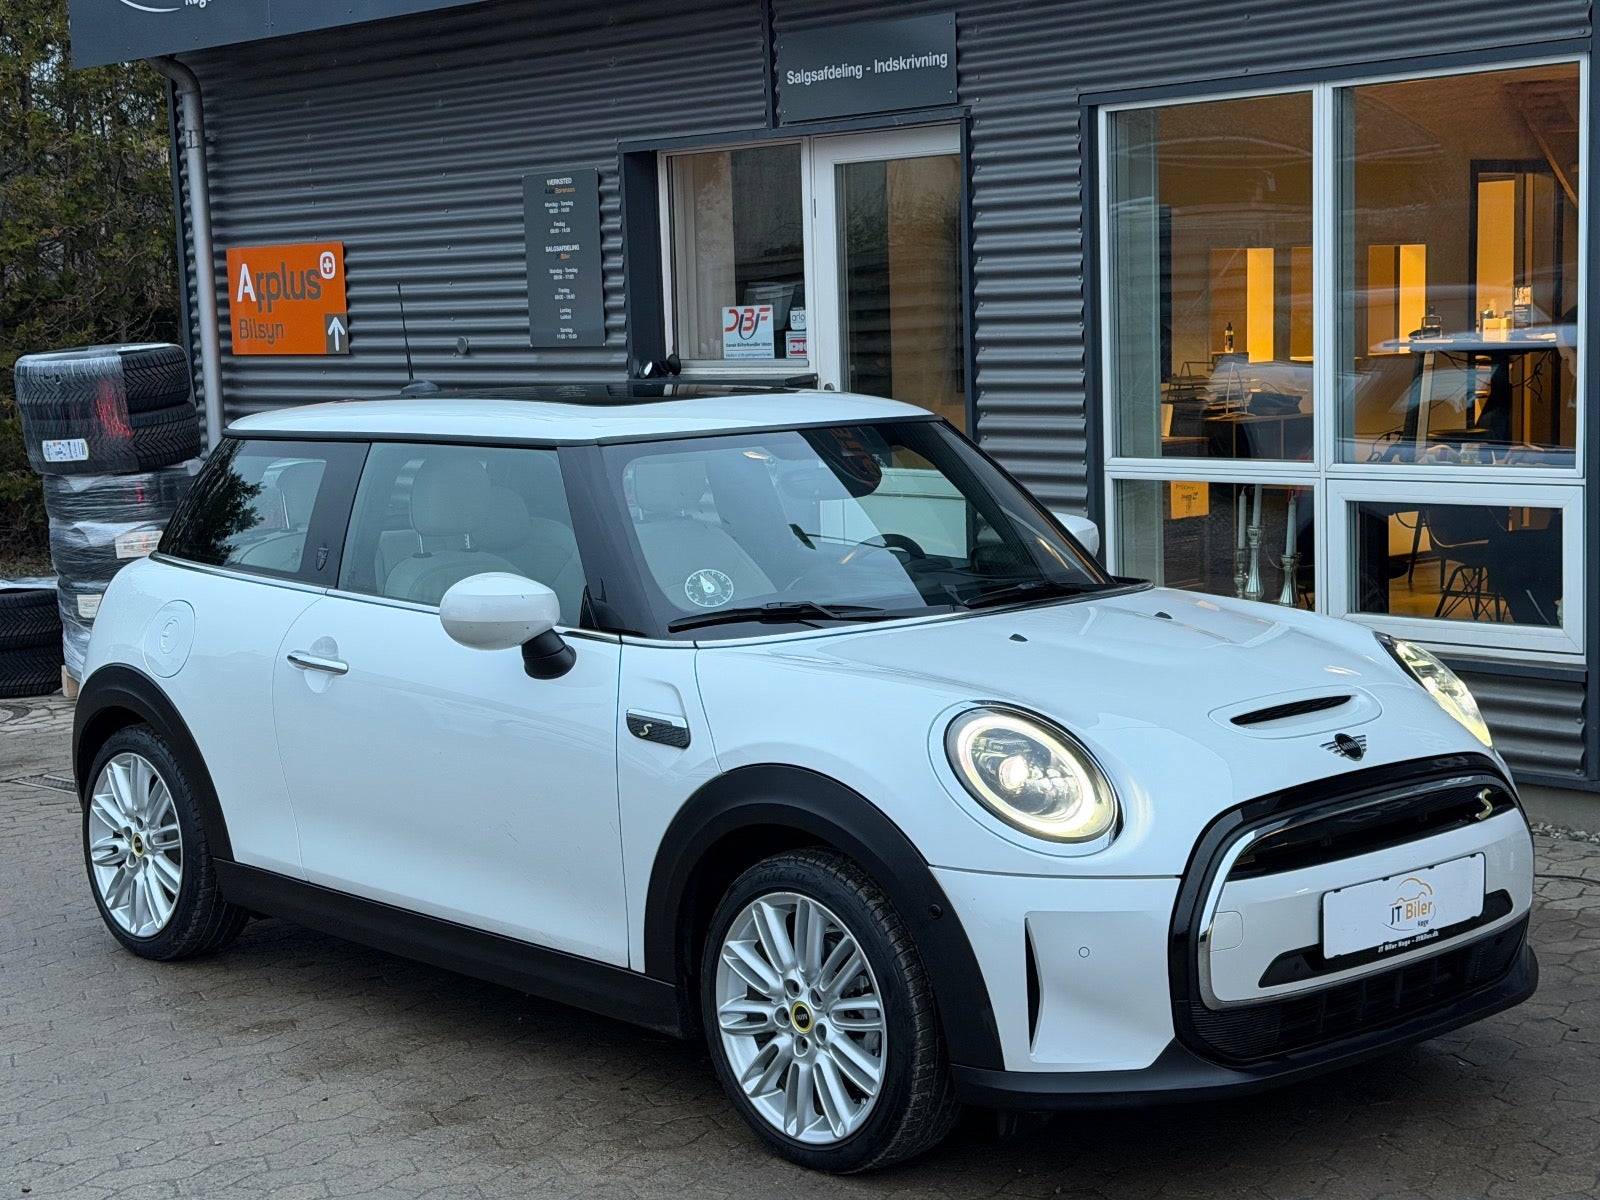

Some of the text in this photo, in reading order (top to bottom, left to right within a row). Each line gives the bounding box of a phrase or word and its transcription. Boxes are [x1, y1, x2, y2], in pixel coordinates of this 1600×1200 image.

[787, 64, 863, 85] Salgsafdeling
[874, 52, 948, 74] Indskrivning
[239, 318, 285, 346] Bilsyn
[1391, 900, 1433, 926] JT Biler
